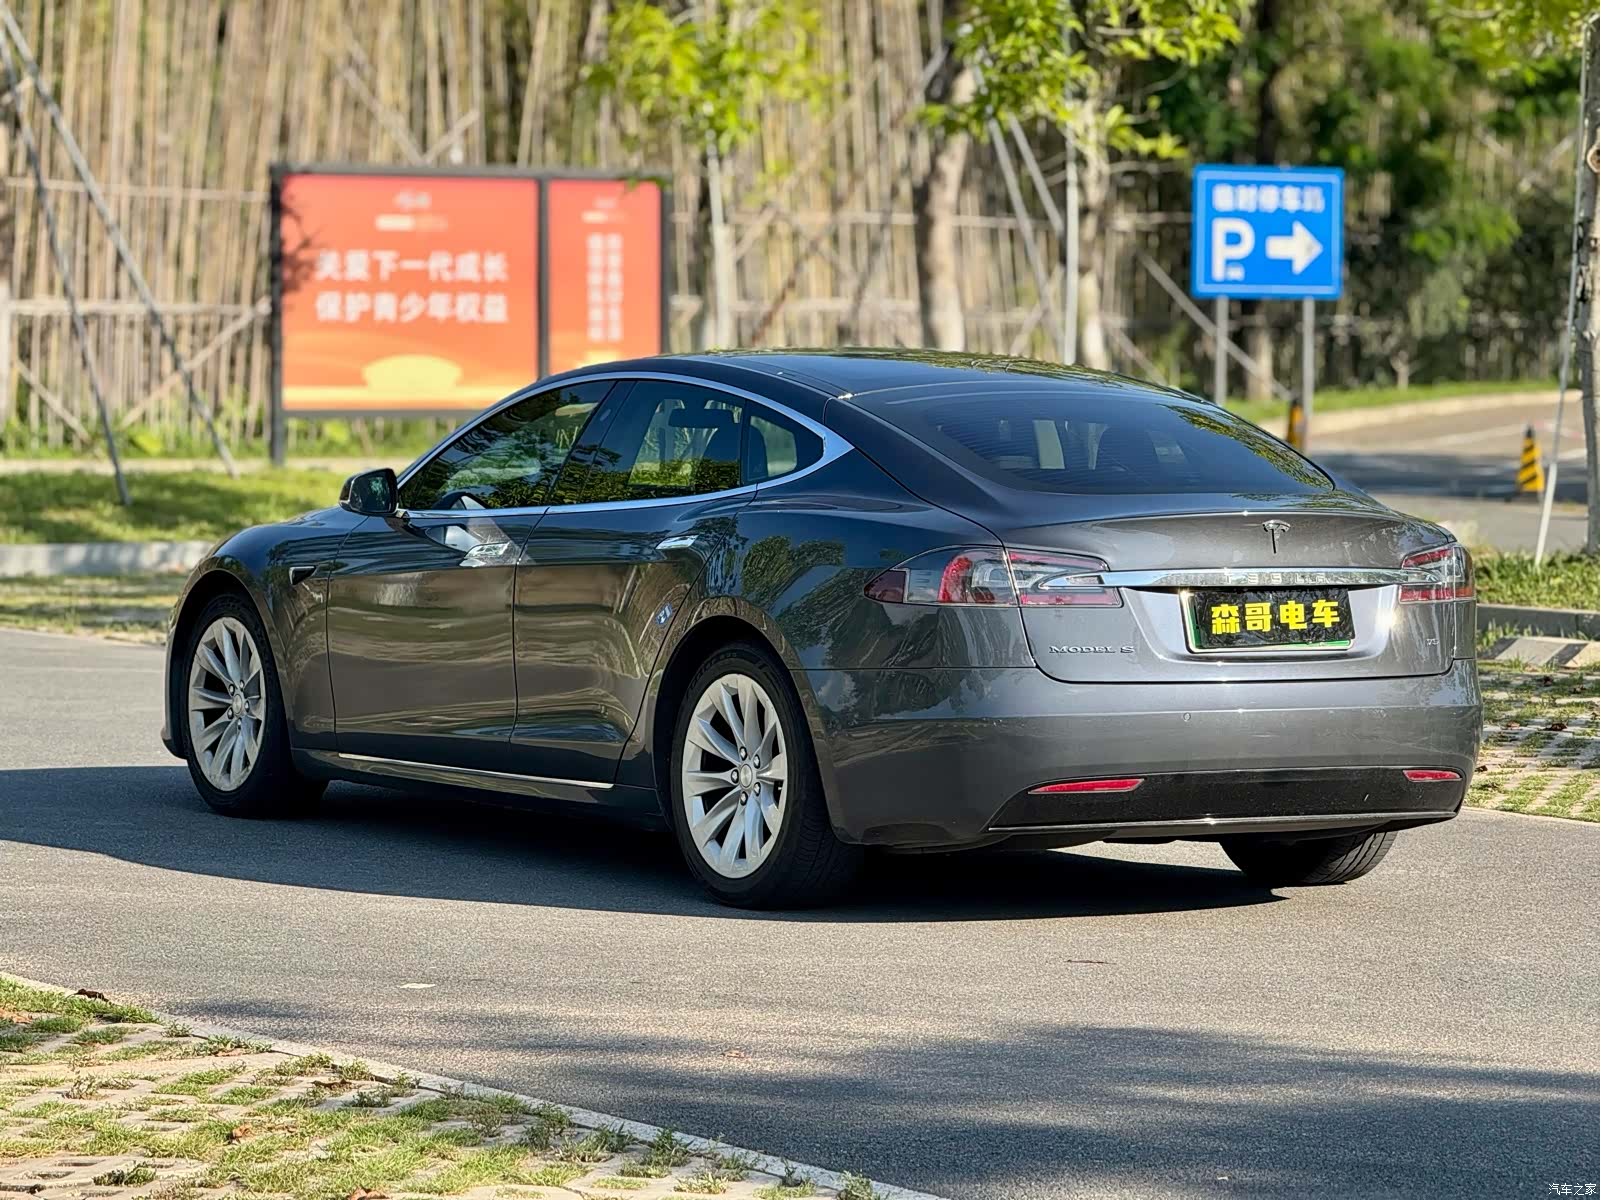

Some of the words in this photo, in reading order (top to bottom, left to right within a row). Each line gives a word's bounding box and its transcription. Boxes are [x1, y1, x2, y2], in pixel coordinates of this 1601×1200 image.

[1211, 217, 1255, 281] P
[315, 290, 509, 323] 保护青少年权益
[1211, 600, 1340, 634] 森哥电车
[1049, 645, 1116, 654] MODEL
[1120, 645, 1135, 654] S
